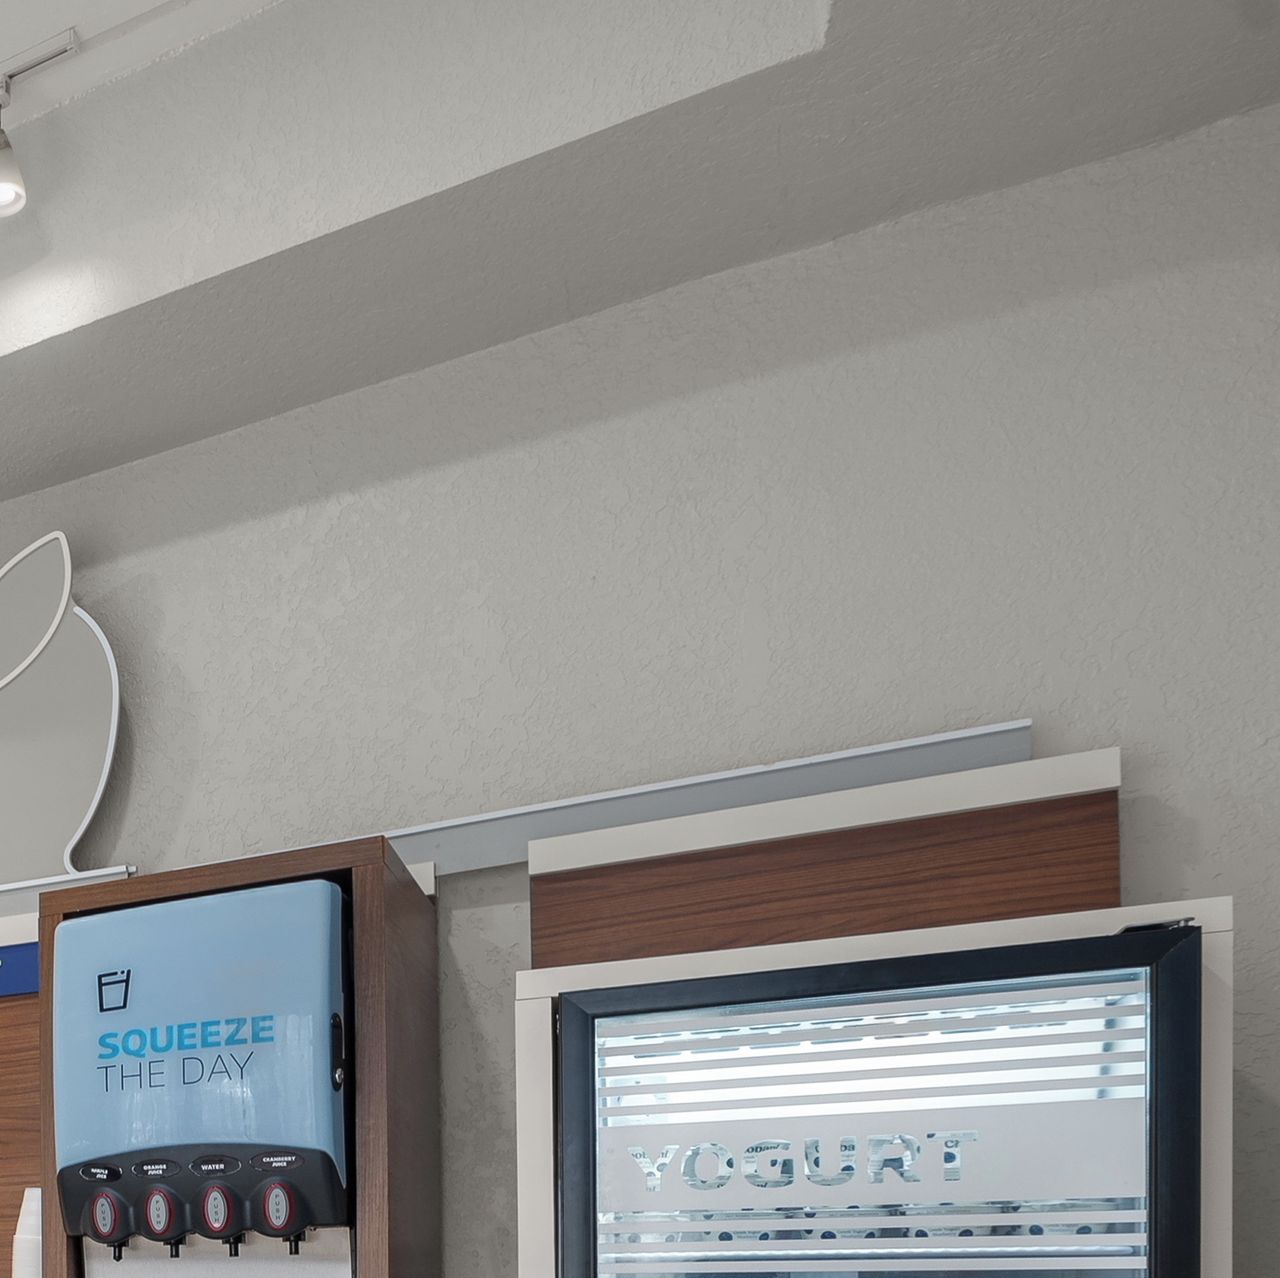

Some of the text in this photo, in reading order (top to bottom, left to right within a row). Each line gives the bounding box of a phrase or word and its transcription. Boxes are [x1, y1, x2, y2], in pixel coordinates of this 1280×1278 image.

[98, 1015, 274, 1059] SQUEEZE
[97, 1051, 254, 1092] THE DAY
[201, 1163, 225, 1171] WATER
[627, 1130, 979, 1192] YOGURT
